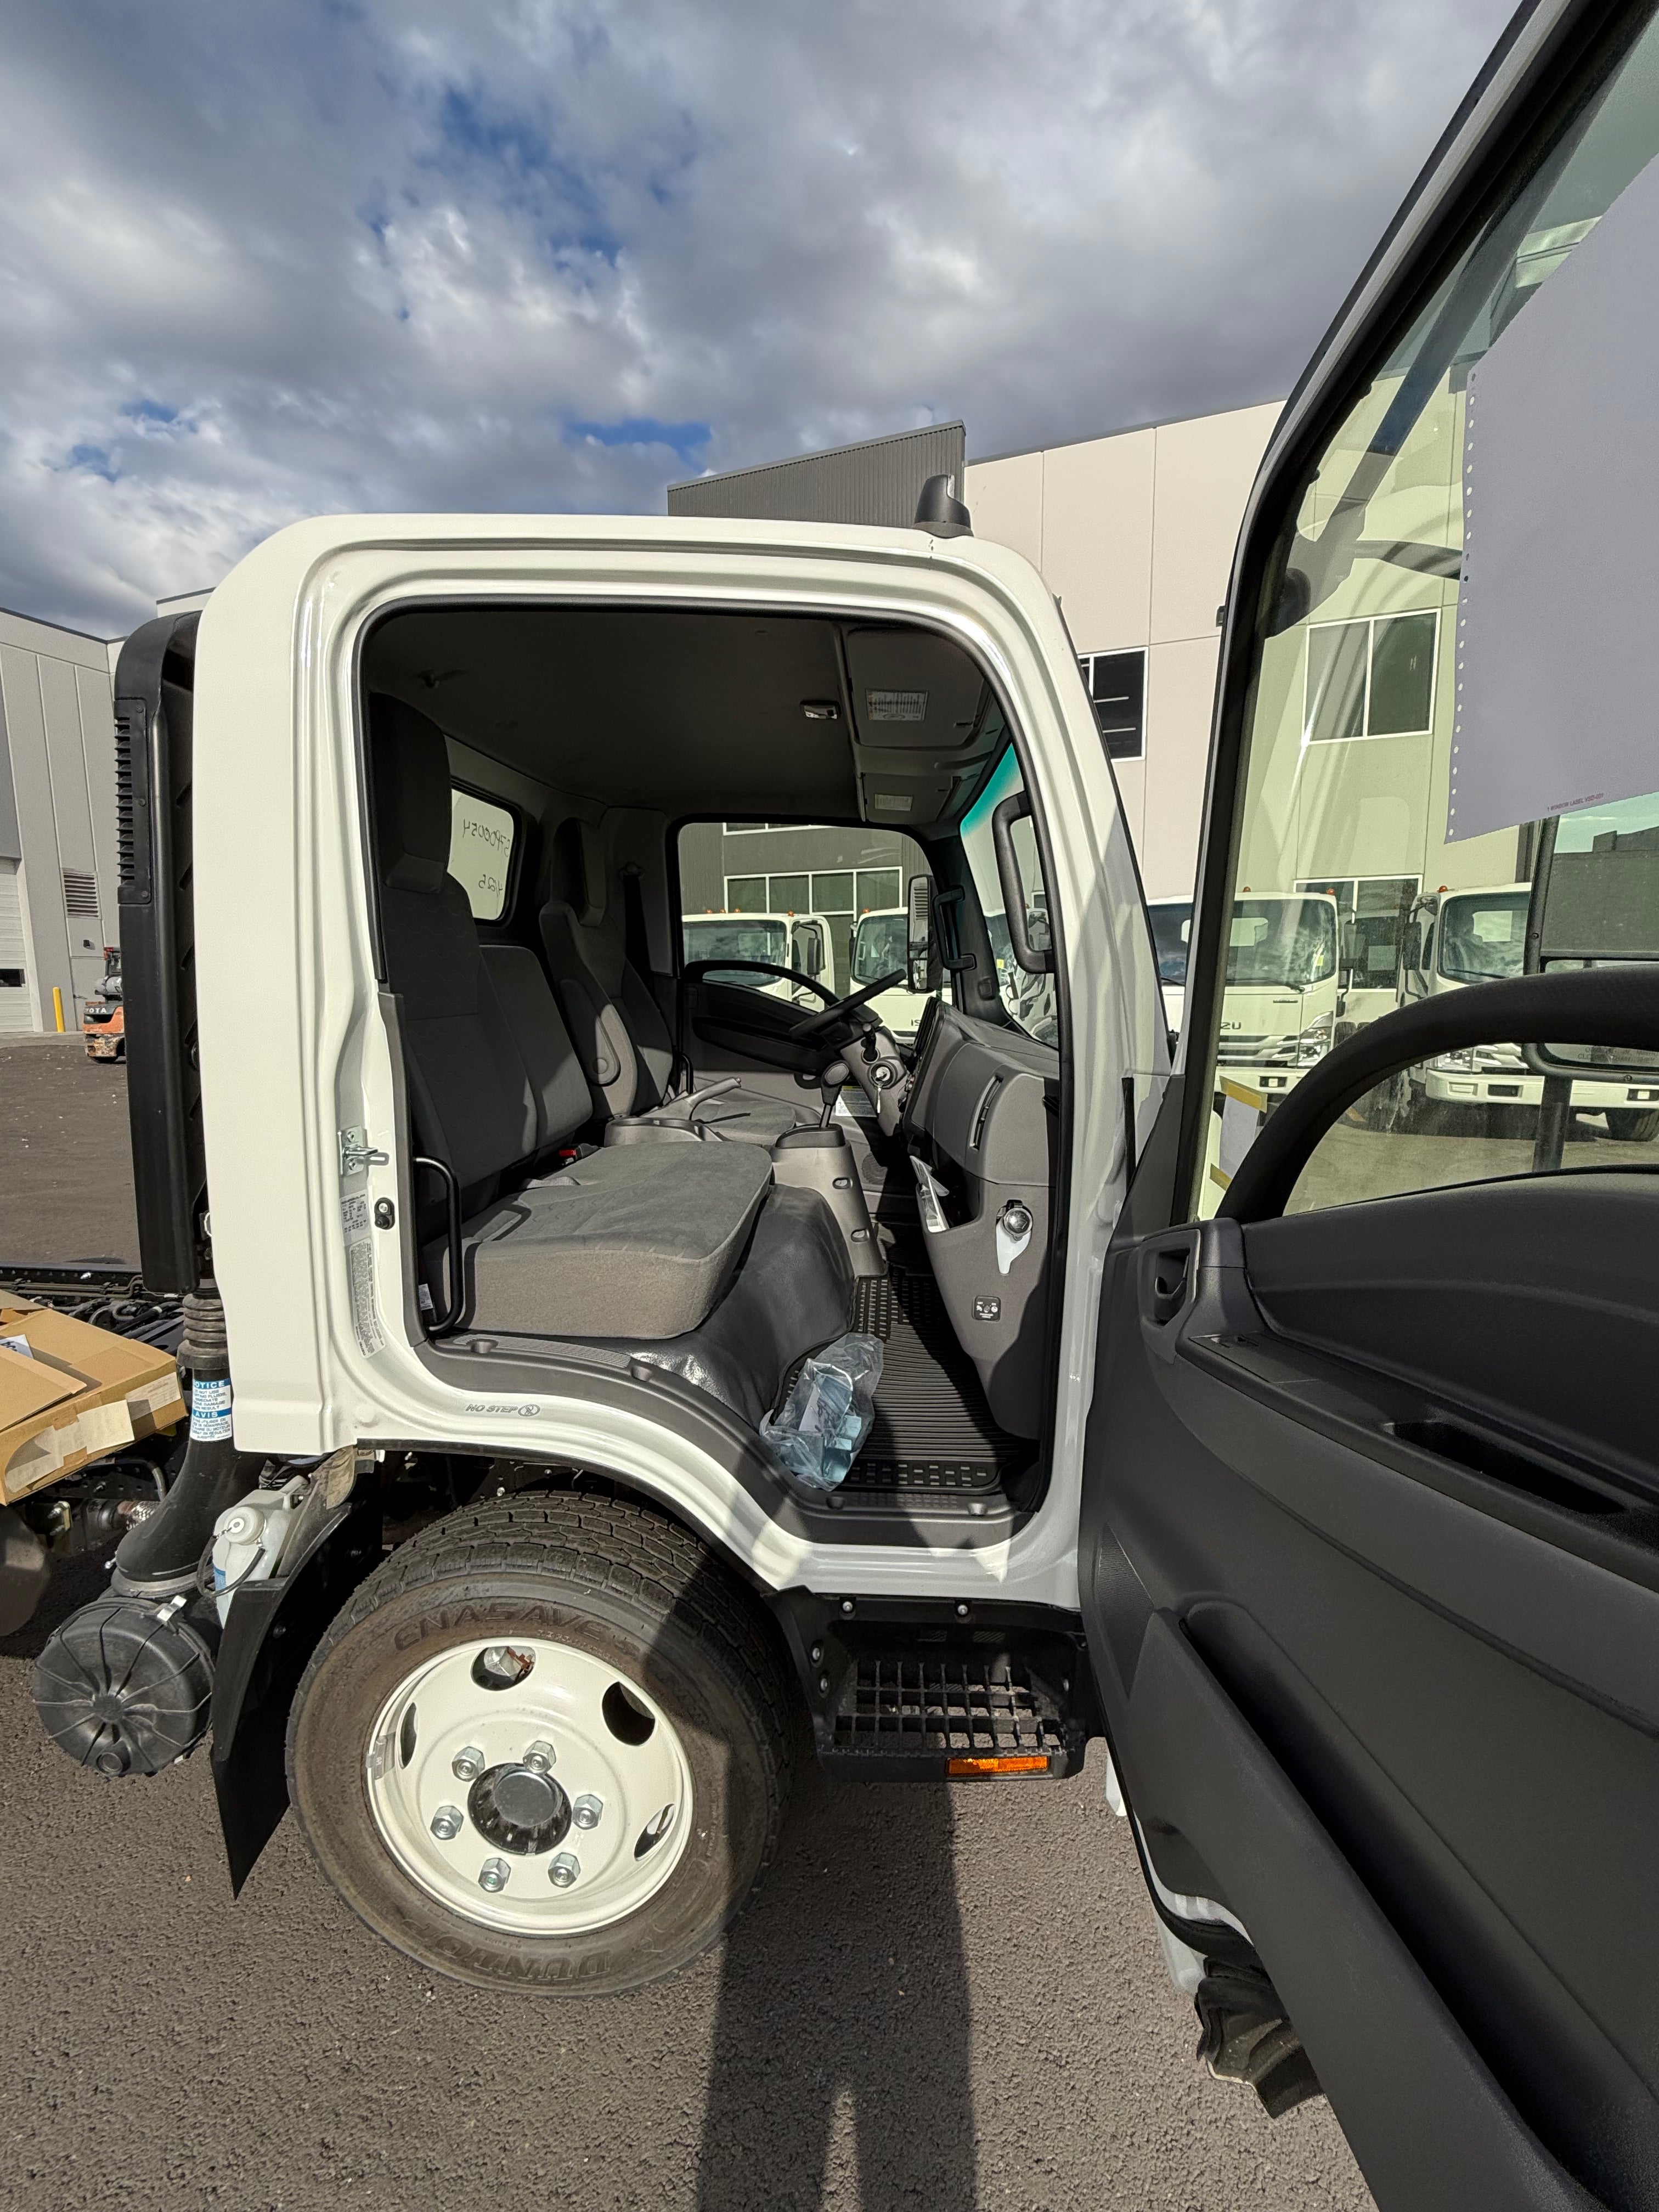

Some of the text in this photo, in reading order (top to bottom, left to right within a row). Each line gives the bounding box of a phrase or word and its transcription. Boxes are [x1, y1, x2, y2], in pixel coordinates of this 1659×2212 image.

[465, 1403, 518, 1413] NO STEP
[394, 1602, 611, 1651] ENASAVE
[403, 1920, 611, 1982] DUNLOP
